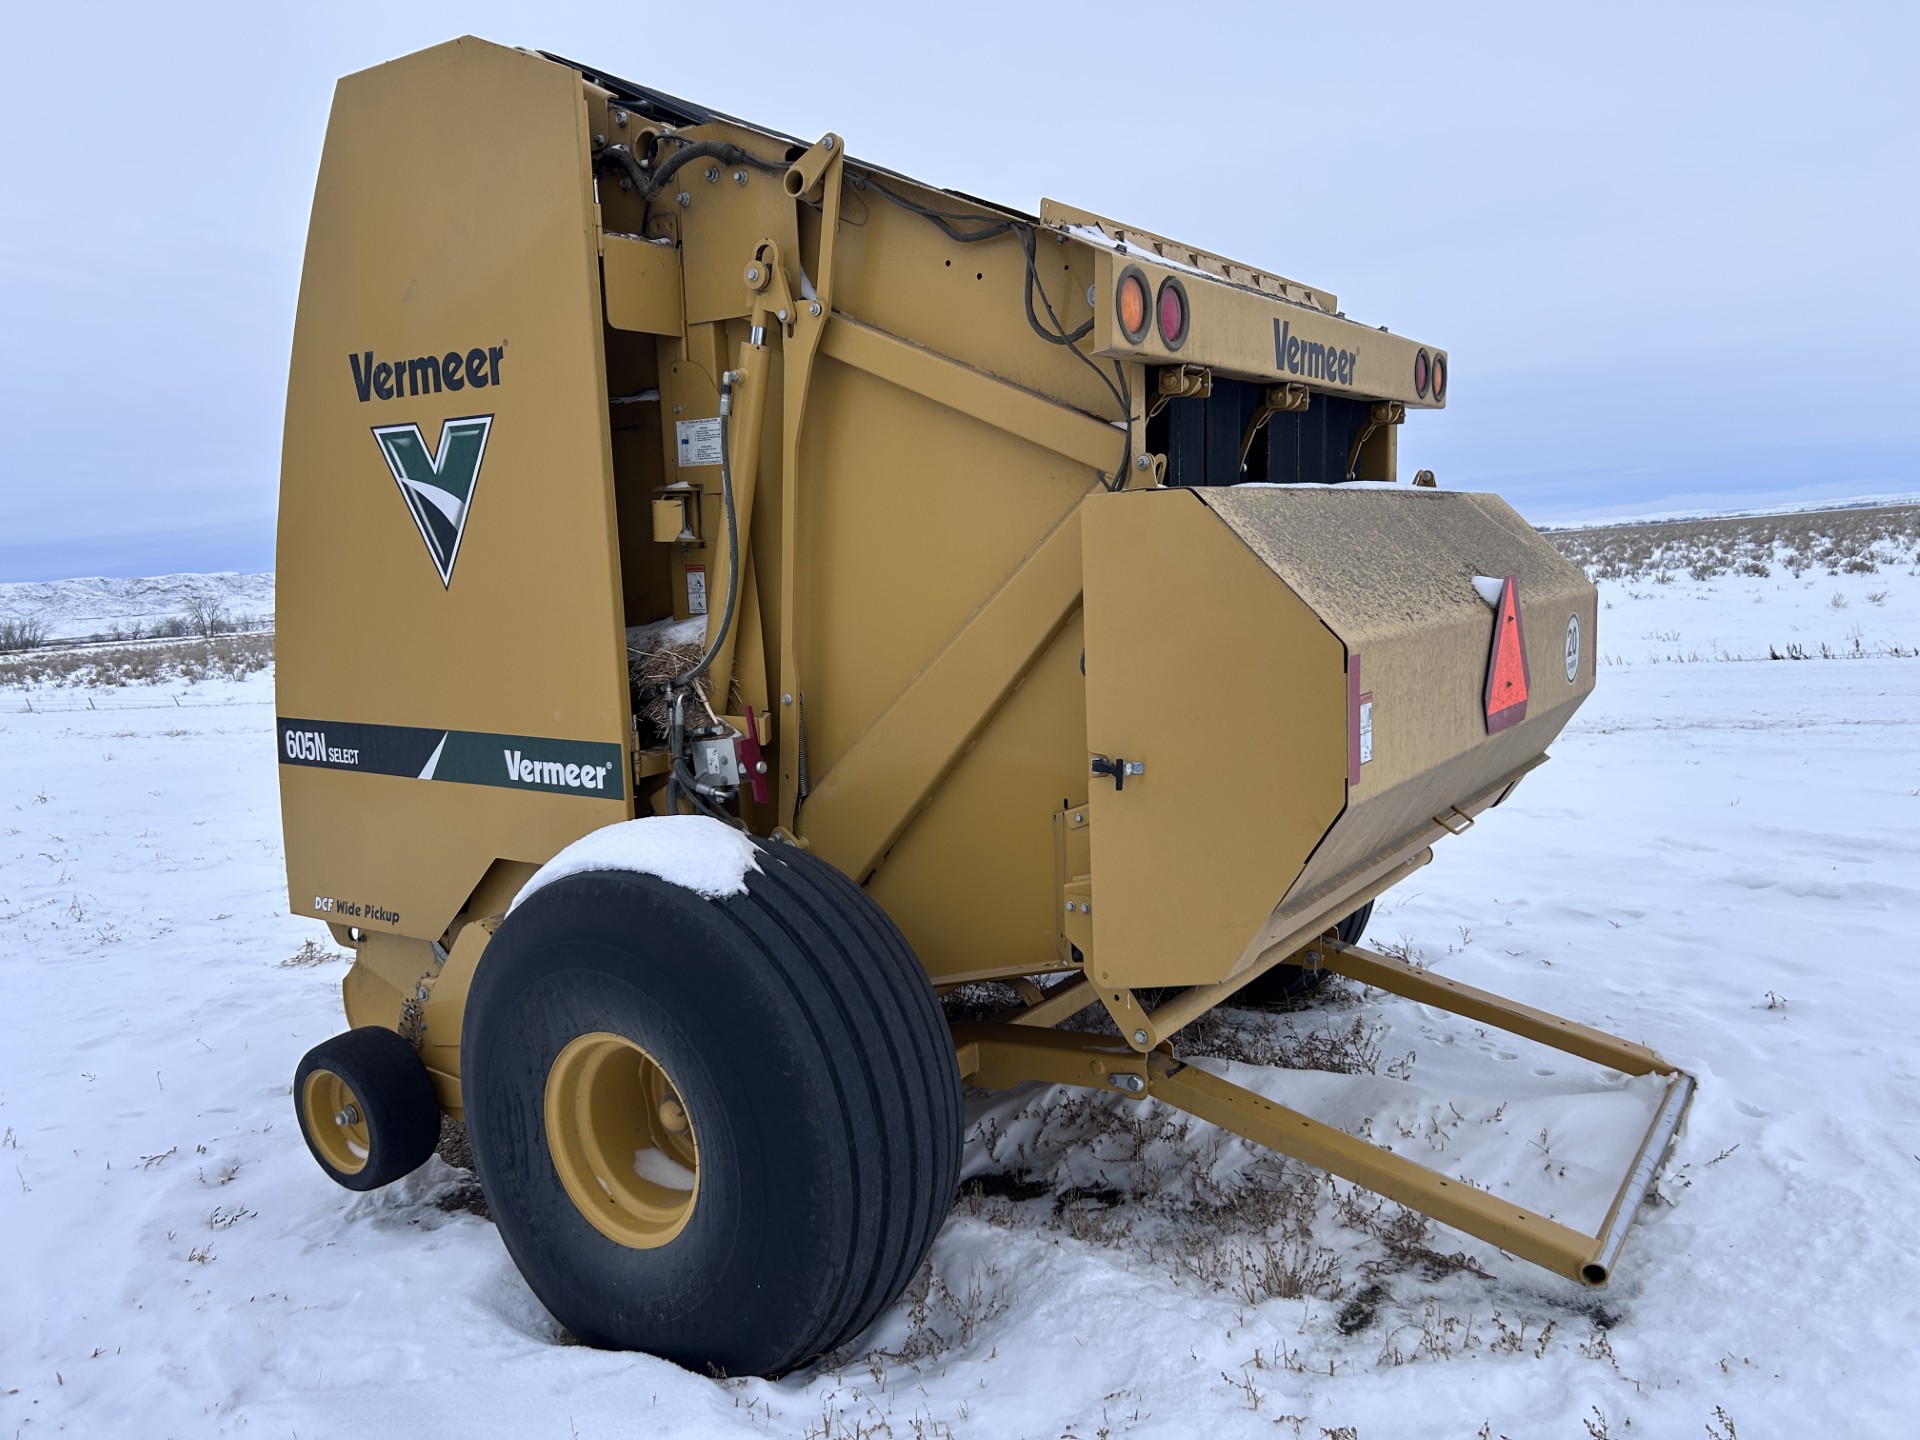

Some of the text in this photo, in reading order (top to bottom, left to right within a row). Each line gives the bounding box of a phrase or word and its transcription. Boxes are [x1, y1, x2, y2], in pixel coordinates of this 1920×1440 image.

[1567, 626, 1577, 657] 20
[285, 729, 359, 764] 605N SELECT
[314, 895, 400, 925] DCF Wide Pickup
